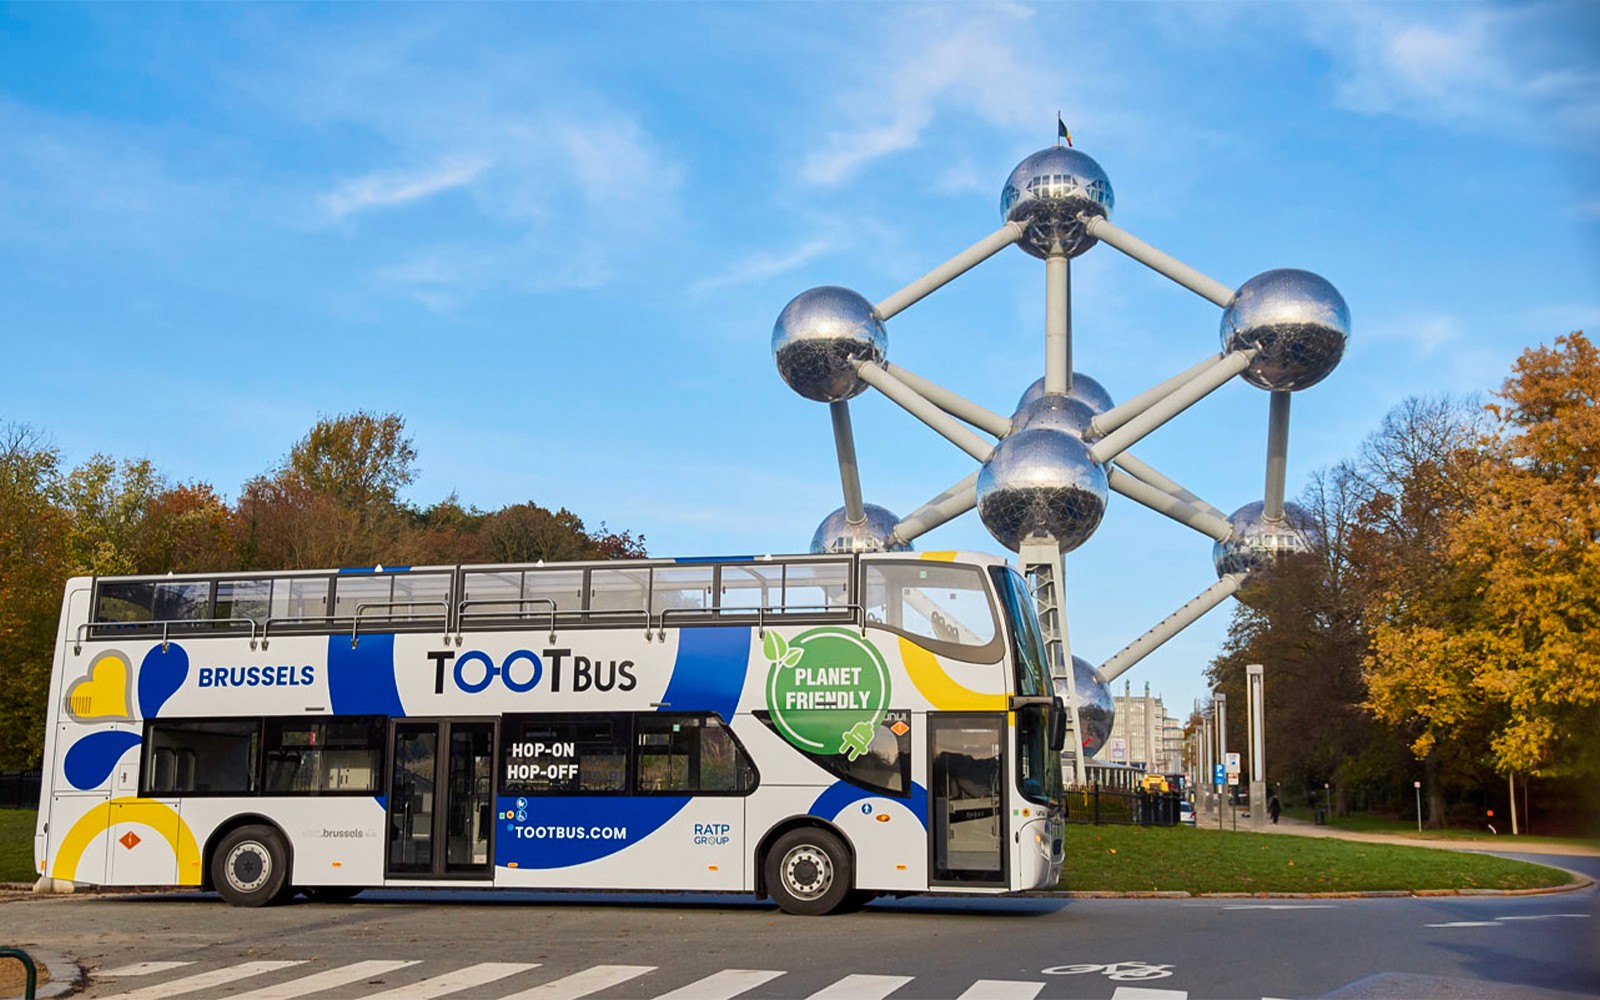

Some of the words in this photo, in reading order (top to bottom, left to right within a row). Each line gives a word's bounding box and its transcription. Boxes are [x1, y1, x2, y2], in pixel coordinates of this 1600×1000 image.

[198, 665, 315, 688] BRUSSELS
[795, 667, 862, 686] PLANET
[785, 690, 871, 710] FRIENDLY
[512, 742, 575, 758] HOP-ON
[507, 764, 579, 779] HOP-OFF
[515, 826, 627, 840] TOOTBUS.COM
[694, 823, 730, 835] RATP
[693, 836, 730, 845] GROUP
